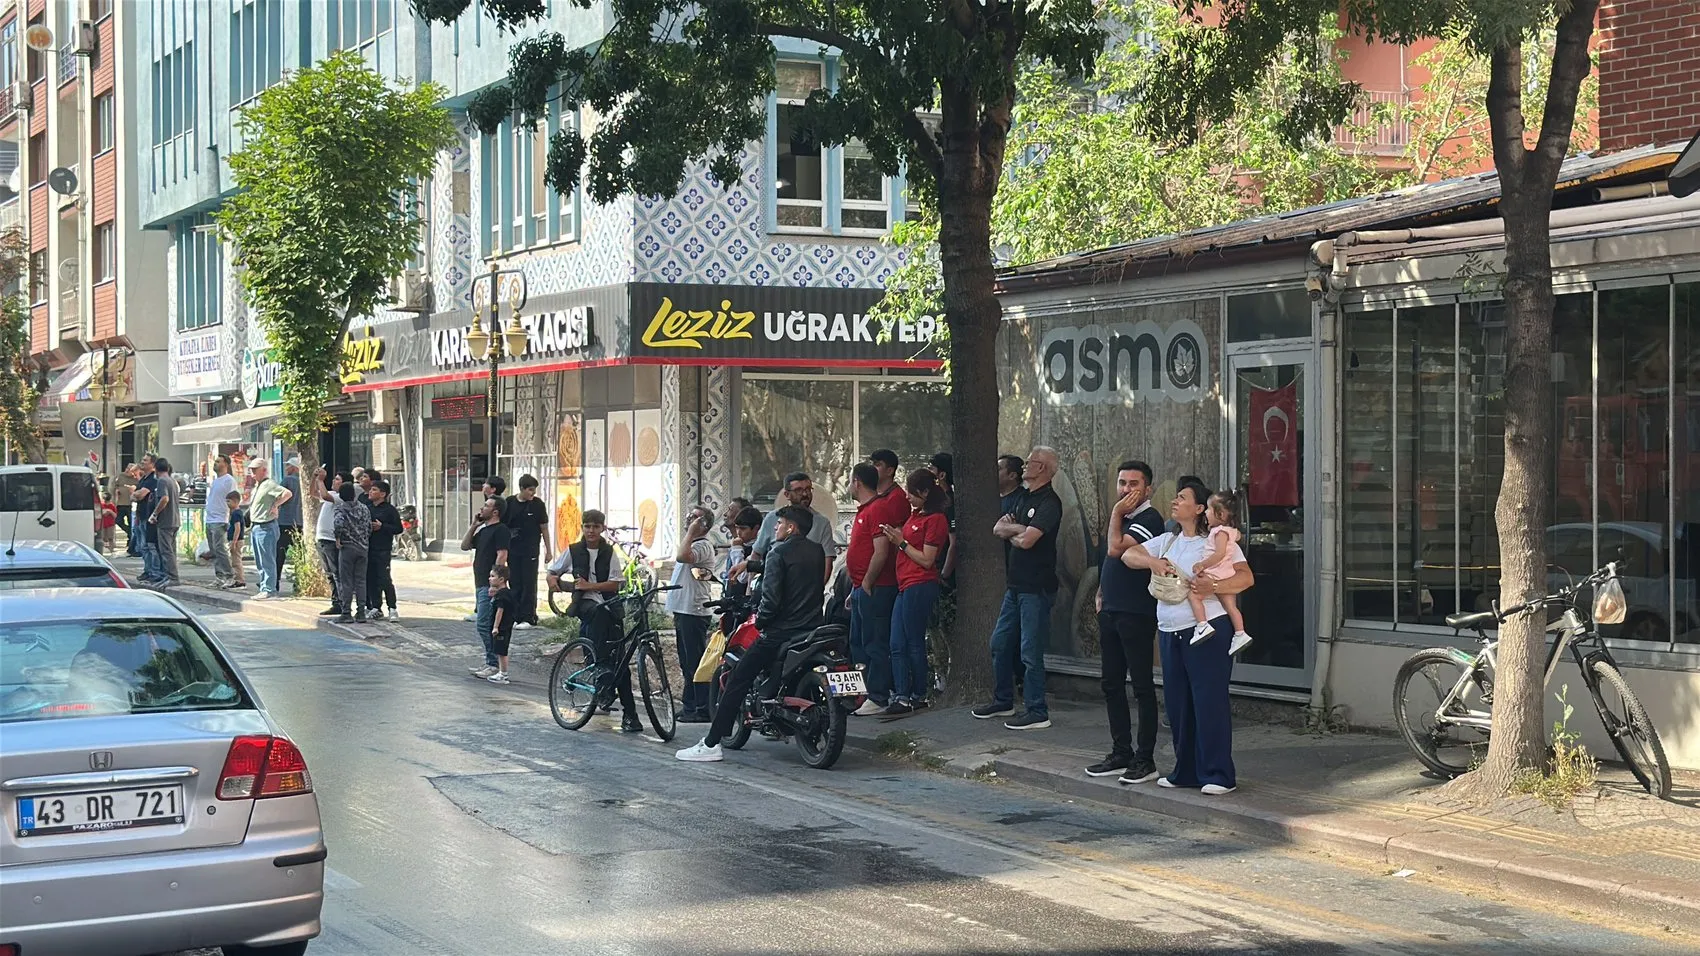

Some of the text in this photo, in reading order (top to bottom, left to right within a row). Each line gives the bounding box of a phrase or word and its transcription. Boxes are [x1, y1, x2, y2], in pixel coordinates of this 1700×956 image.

[641, 296, 756, 349] Leziz
[763, 310, 873, 342] UĞRAK
[1044, 331, 1201, 394] asma
[839, 683, 857, 692] 765
[22, 790, 176, 825] TR 43 DR 721
